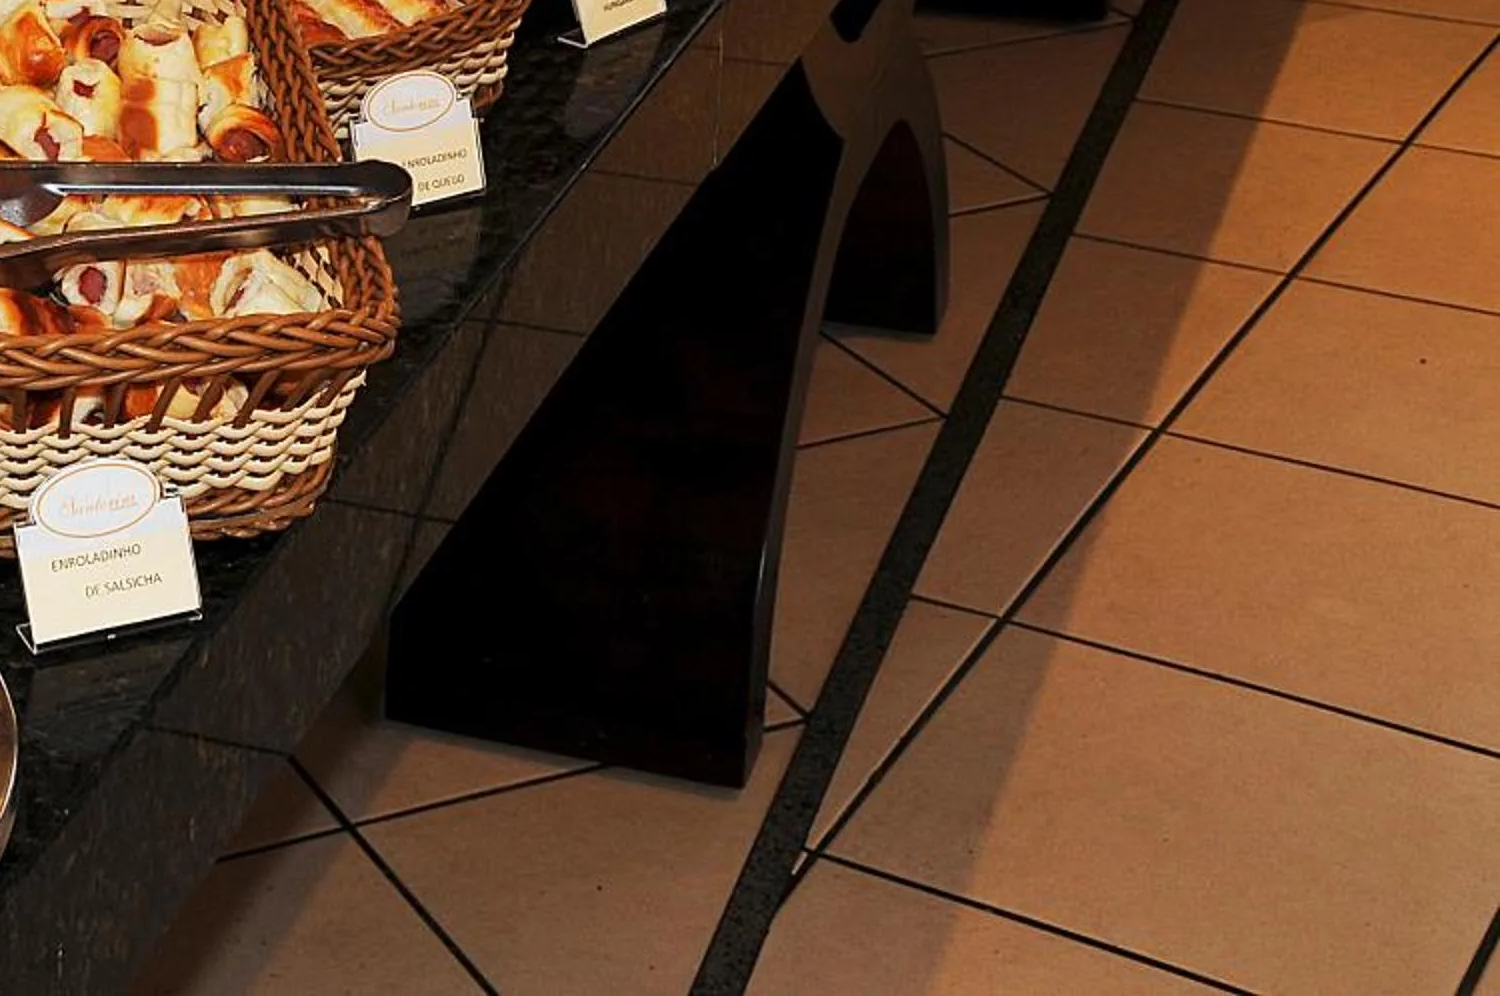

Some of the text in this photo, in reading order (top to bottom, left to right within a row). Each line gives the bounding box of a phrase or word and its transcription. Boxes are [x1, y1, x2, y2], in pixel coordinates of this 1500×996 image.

[51, 543, 141, 572] ENROLADINHO
[85, 572, 163, 598] DE SALSICHA
